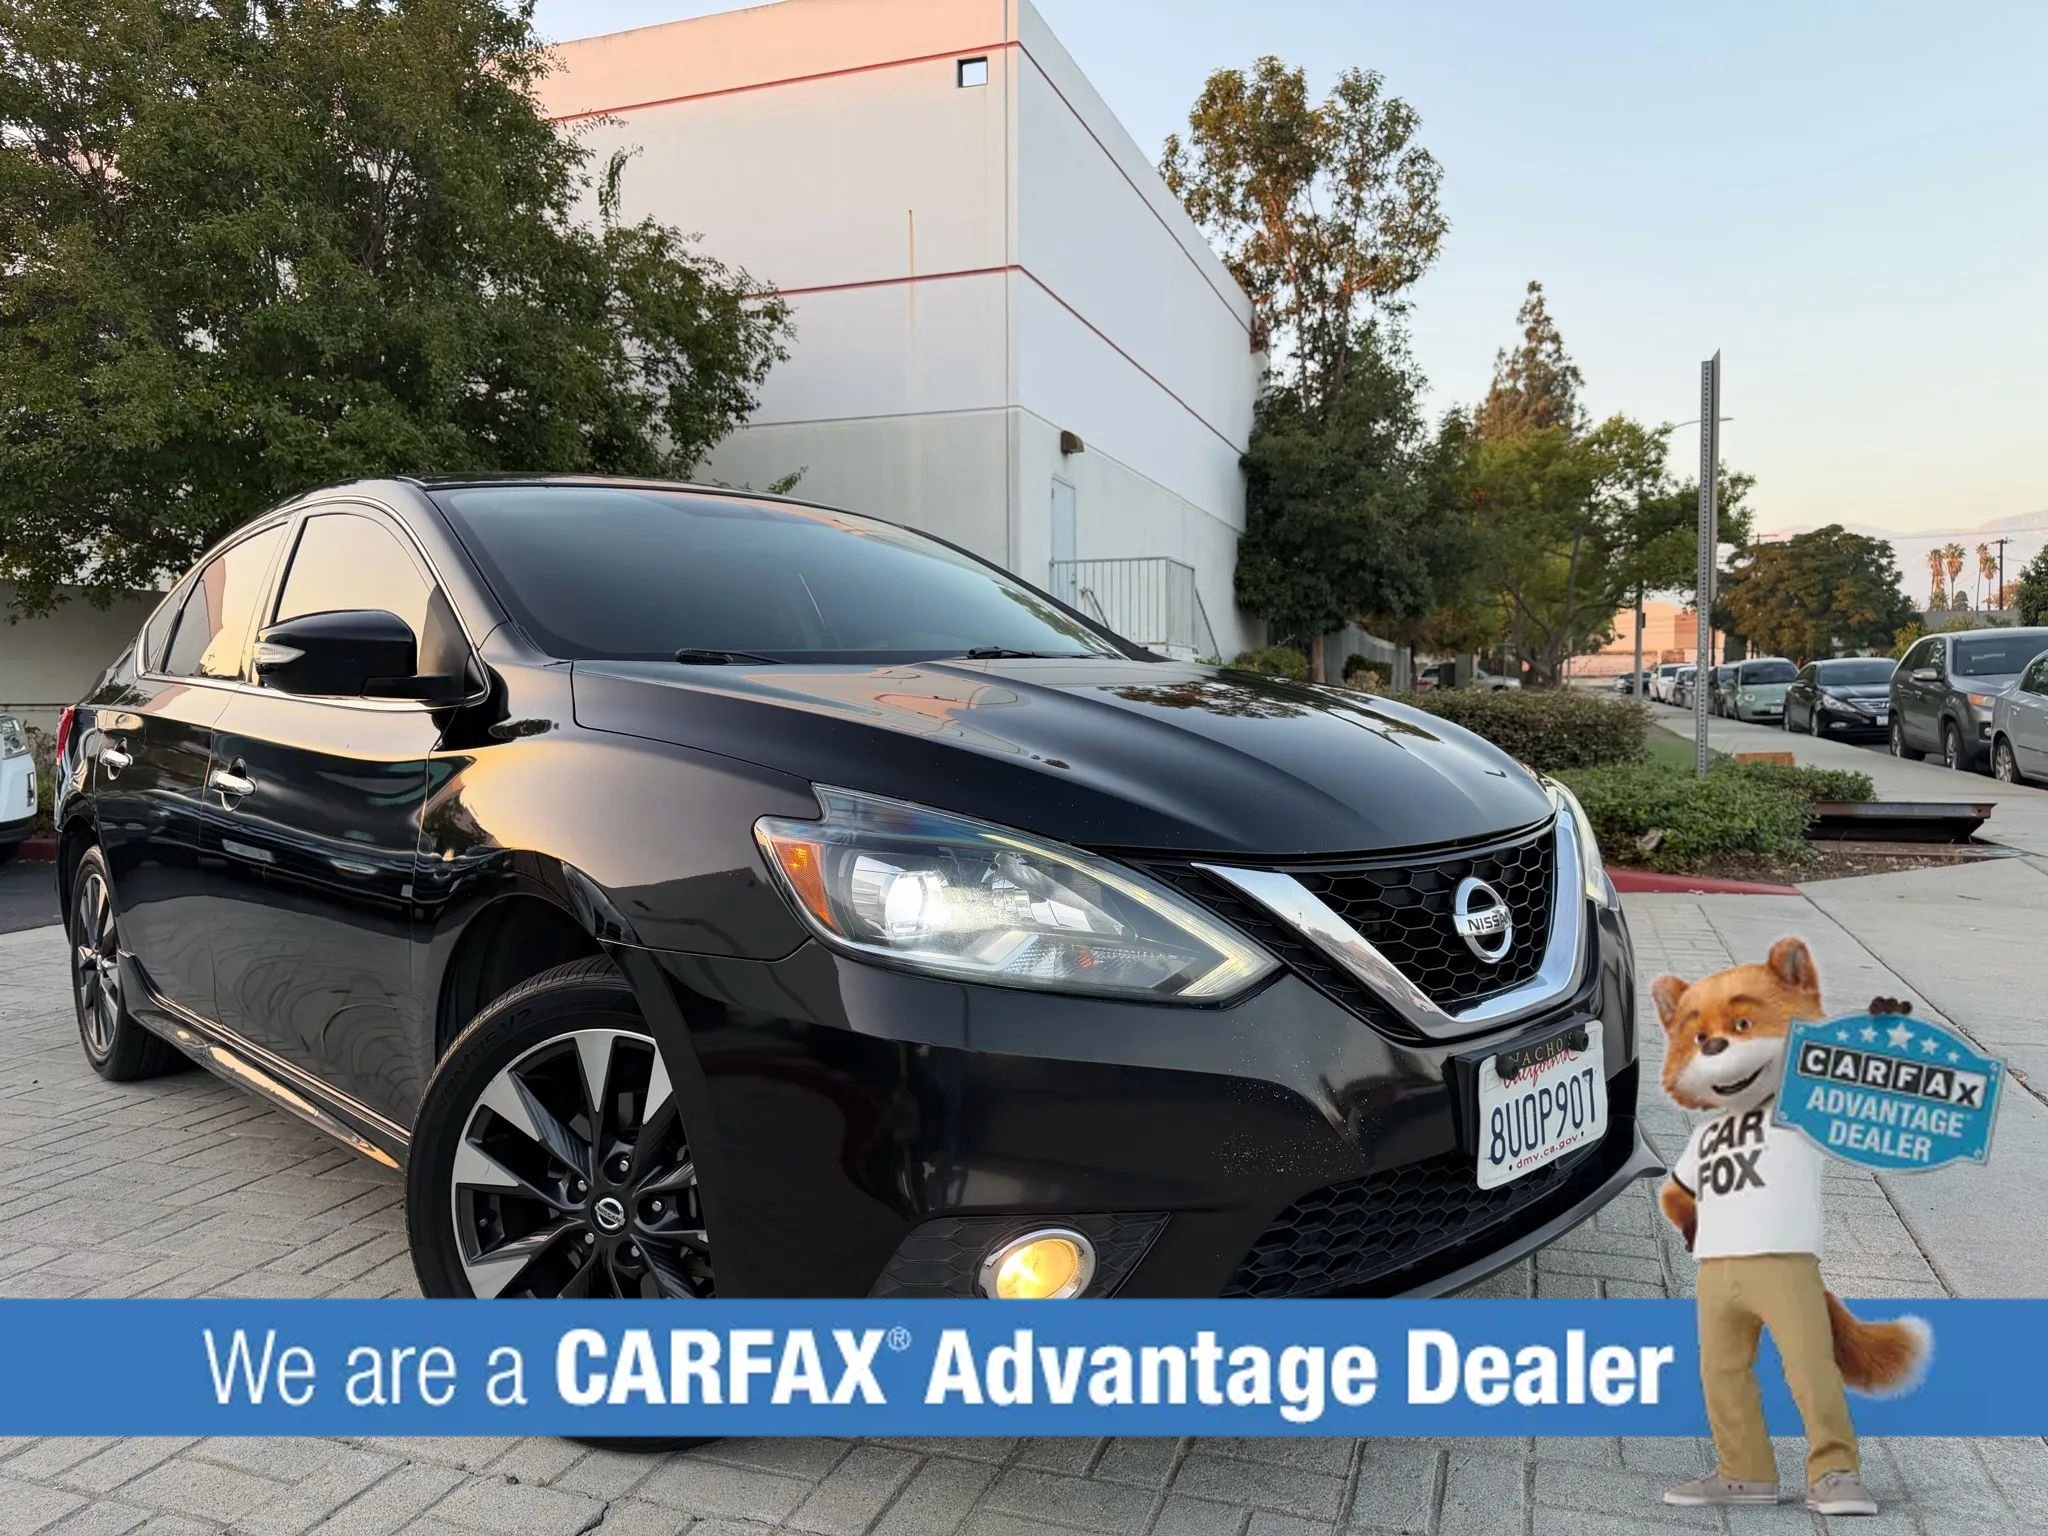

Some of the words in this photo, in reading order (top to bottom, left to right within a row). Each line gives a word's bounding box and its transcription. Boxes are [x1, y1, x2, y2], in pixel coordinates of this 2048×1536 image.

[1467, 911, 1511, 932] NISSAN
[1490, 1067, 1596, 1166] 8UOP907
[1516, 1135, 1578, 1169] dmv.ca.gov
